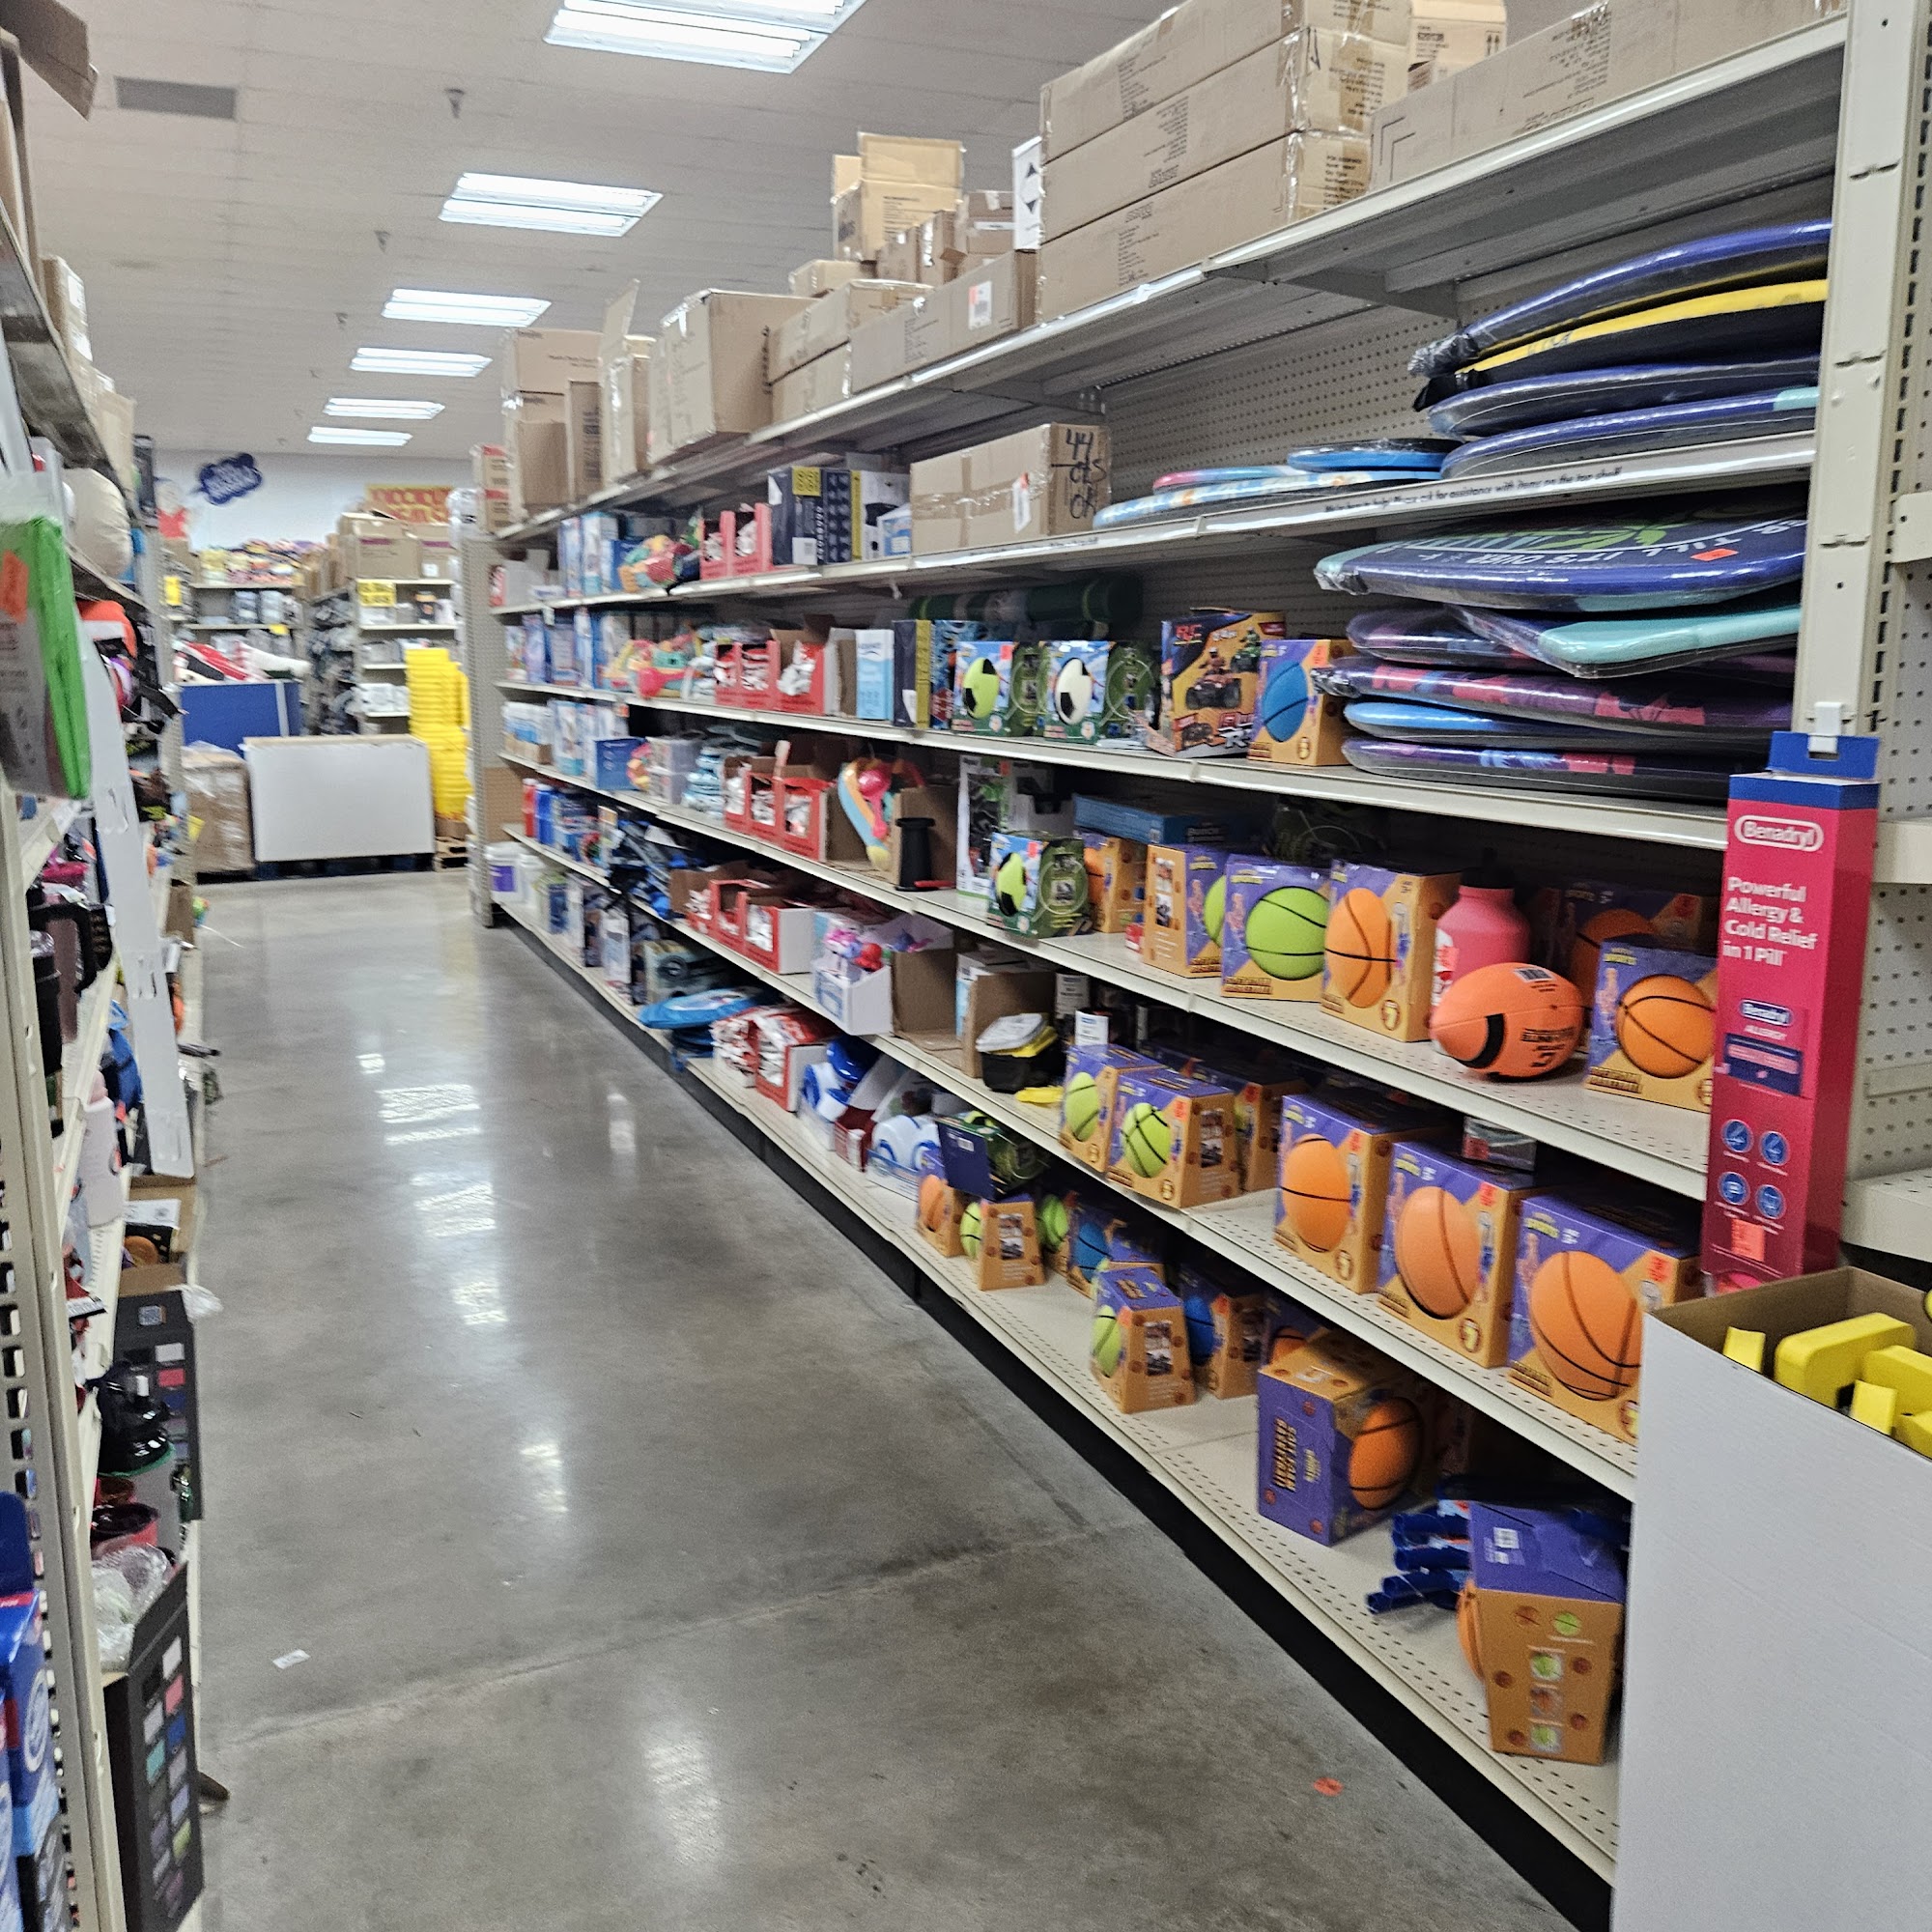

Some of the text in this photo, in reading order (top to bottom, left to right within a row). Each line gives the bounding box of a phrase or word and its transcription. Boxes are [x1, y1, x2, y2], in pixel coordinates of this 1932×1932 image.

[1436, 488, 1449, 499] for
[1449, 486, 1492, 498] assistance
[1495, 480, 1514, 492] with
[1642, 537, 1742, 557] TILL
[1465, 554, 1547, 566] OVER
[1546, 551, 1624, 565] IT'S
[1742, 820, 1815, 849] Benadryl
[1726, 876, 1807, 903] Powerful
[1724, 896, 1804, 923] Allergy &
[1723, 919, 1819, 951] Cold Relief
[1721, 940, 1742, 957] in
[1743, 945, 1753, 959] 1
